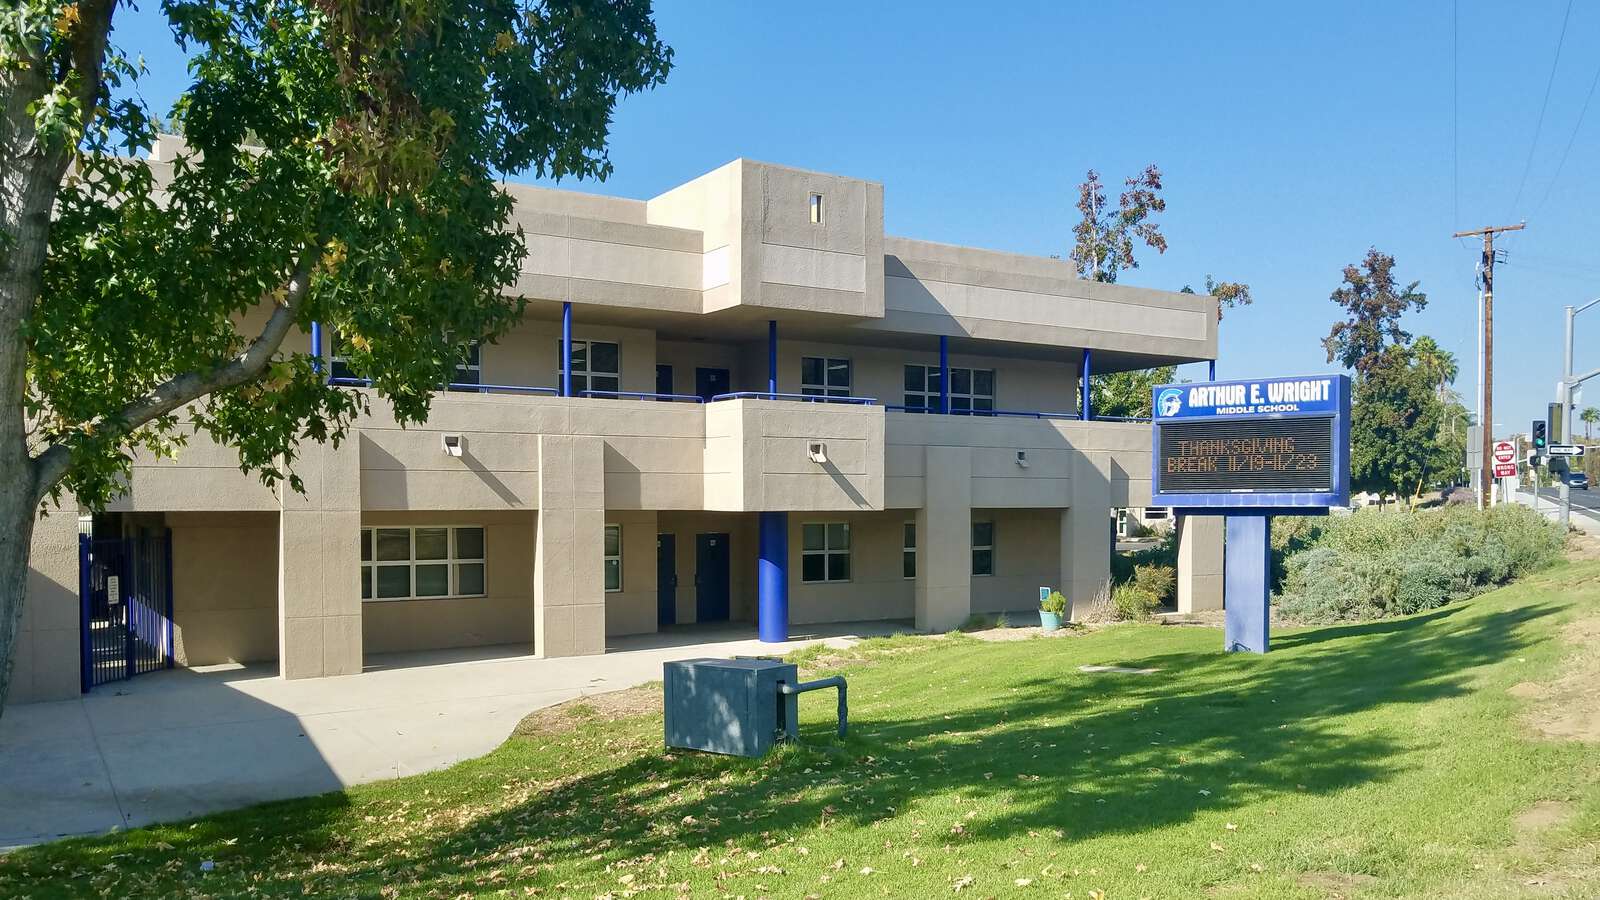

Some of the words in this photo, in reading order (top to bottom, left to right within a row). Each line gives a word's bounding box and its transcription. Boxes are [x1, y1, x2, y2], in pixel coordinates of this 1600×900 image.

[1189, 385, 1246, 408] ARTHUR
[1250, 383, 1265, 404] E.
[1268, 379, 1331, 403] WRIGHT
[1216, 406, 1255, 415] MIDDLE
[1257, 404, 1300, 413] SCHOOL
[1178, 437, 1296, 456] THANKSGIVING
[1167, 457, 1217, 473] BREAK
